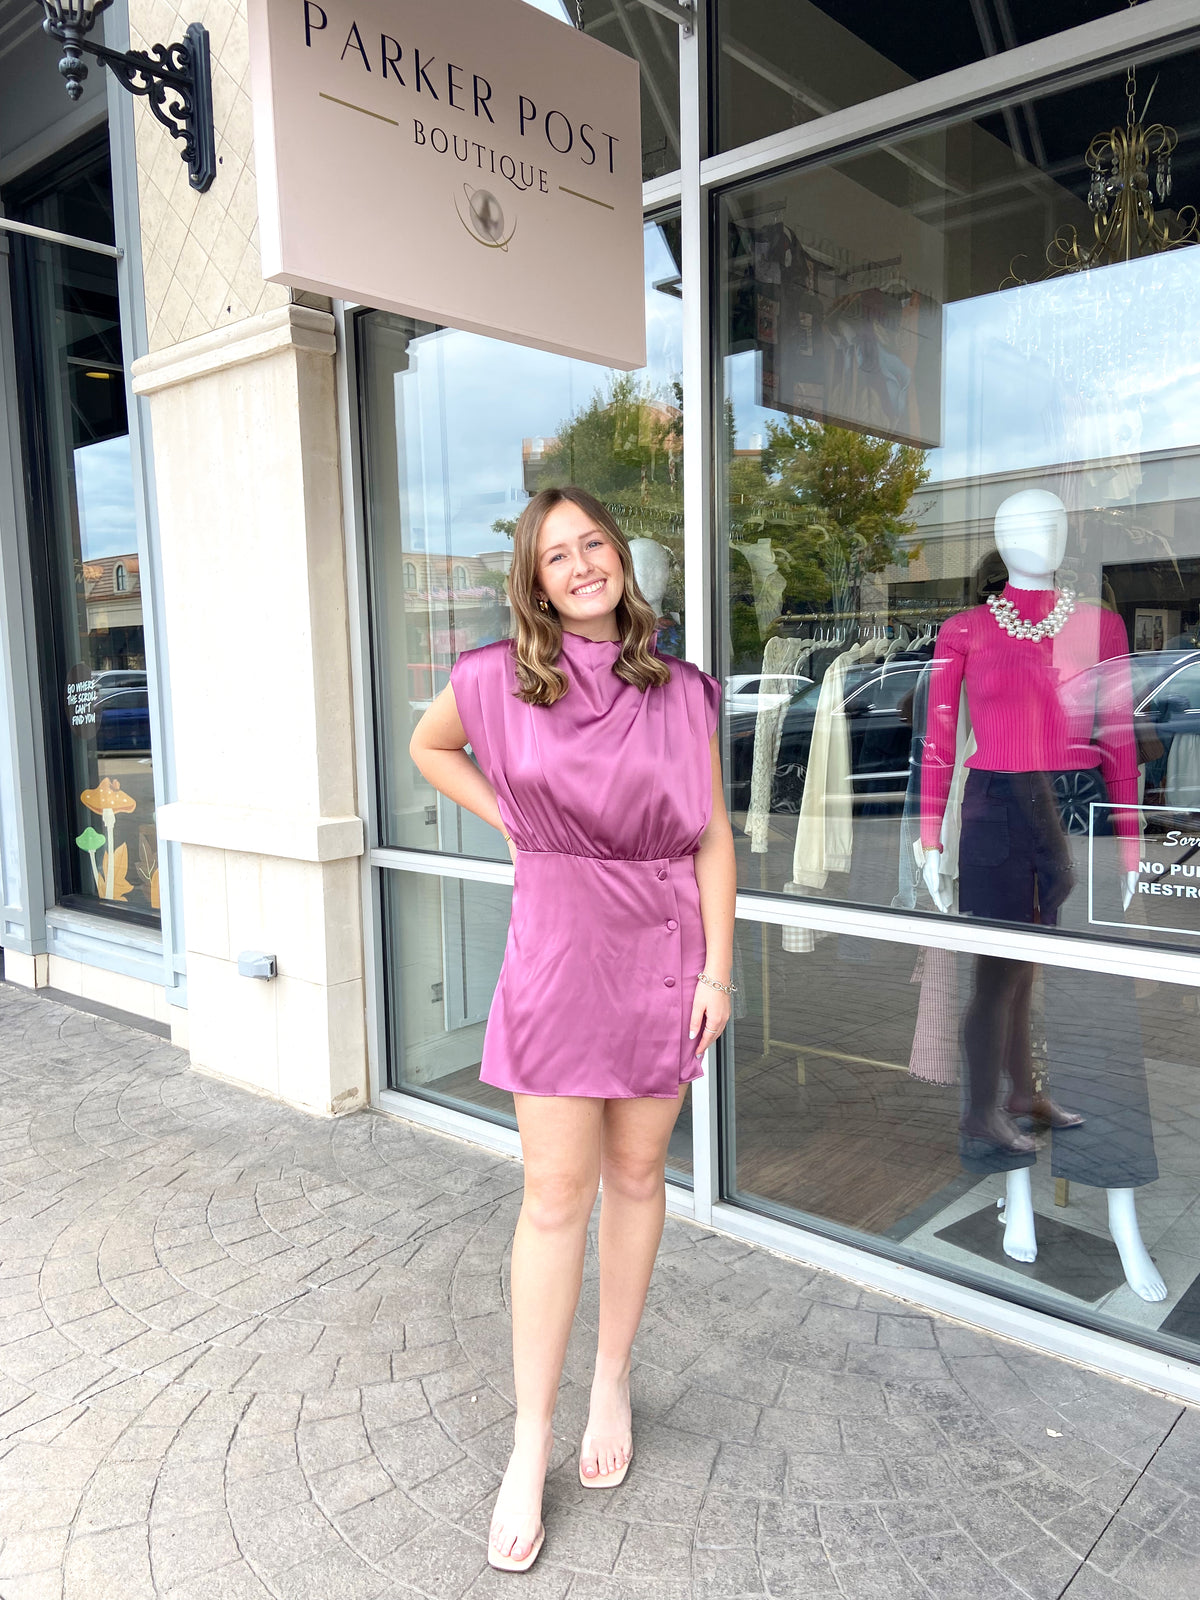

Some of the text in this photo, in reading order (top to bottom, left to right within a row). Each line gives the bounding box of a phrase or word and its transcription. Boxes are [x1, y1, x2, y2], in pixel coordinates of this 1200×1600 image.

[303, 0, 620, 174] PARKER POST
[413, 118, 549, 194] BOUTIQUE
[67, 680, 95, 695] GO WHERE
[78, 691, 98, 702] SCROLL
[75, 702, 91, 714] CAN'T
[72, 712, 95, 725] FIND YOU
[1138, 861, 1164, 875] NO
[1138, 881, 1200, 898] RESTR
